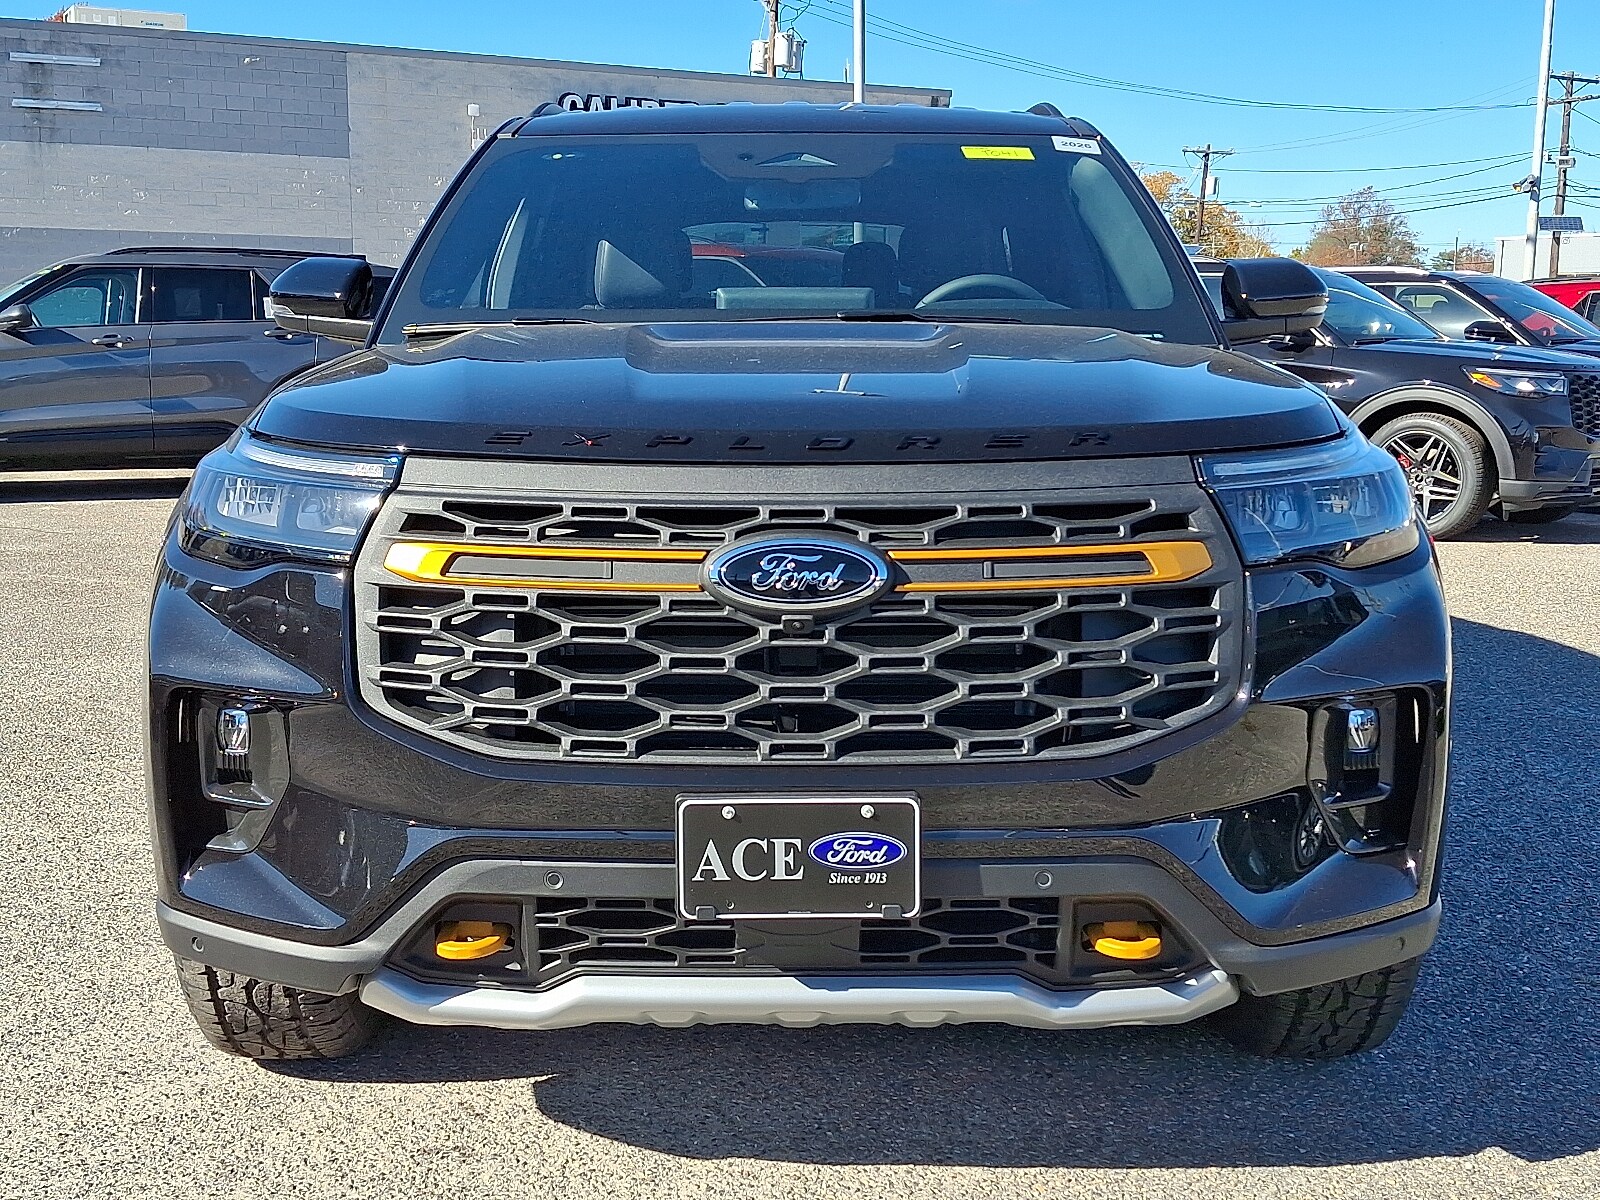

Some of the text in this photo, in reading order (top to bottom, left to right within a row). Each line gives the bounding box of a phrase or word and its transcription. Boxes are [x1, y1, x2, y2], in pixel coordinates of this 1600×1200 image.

[1060, 140, 1093, 149] 2026
[484, 430, 1110, 450] EXPLORER
[751, 552, 846, 591] Ford
[691, 837, 888, 882] ACE Ford
[828, 872, 888, 884] Since 1913
